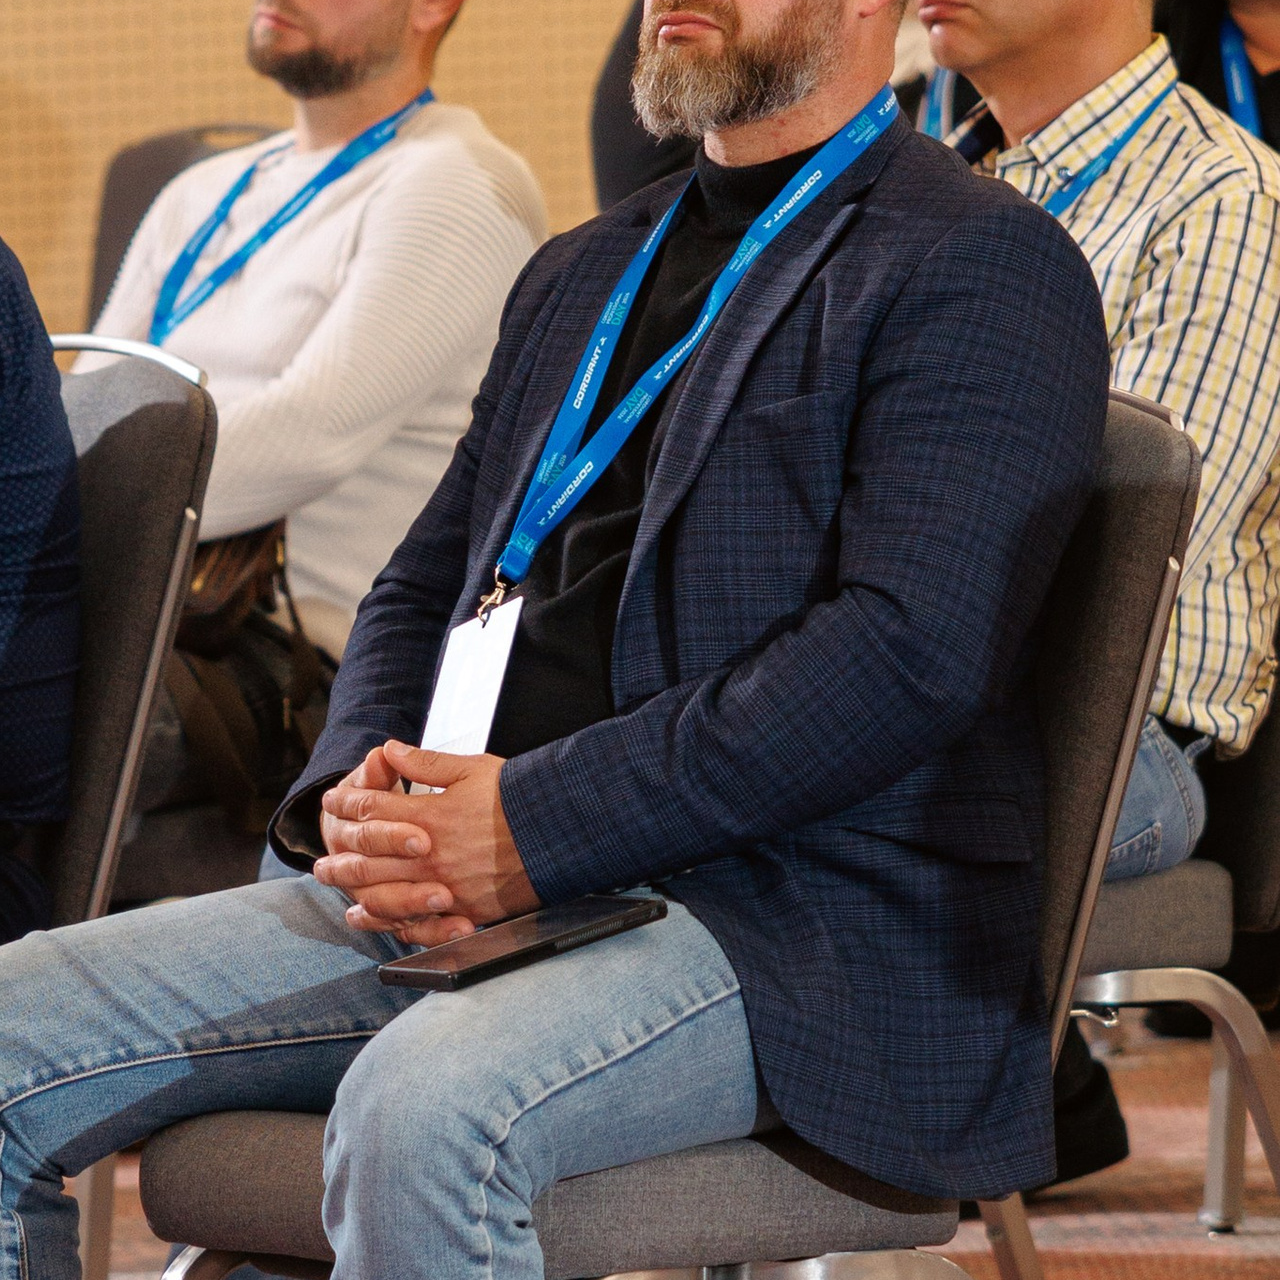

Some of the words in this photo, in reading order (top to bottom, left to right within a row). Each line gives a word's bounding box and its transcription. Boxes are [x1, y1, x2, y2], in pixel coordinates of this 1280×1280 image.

[851, 113, 871, 133] DAY
[773, 170, 823, 223] CORDIANT
[737, 236, 754, 259] DAY
[744, 242, 762, 264] CORDIANT
[600, 301, 613, 323] CORDIANT
[611, 304, 626, 324] DAY
[663, 315, 709, 373] CORDIANT
[572, 346, 602, 409] CORDIANT
[623, 392, 648, 424] PROFESSIONAL
[625, 386, 644, 410] DAY
[634, 395, 652, 418] CORDIANT
[536, 459, 548, 482] CORDIANT
[546, 464, 562, 486] DAY
[548, 461, 594, 520] CORDIANT
